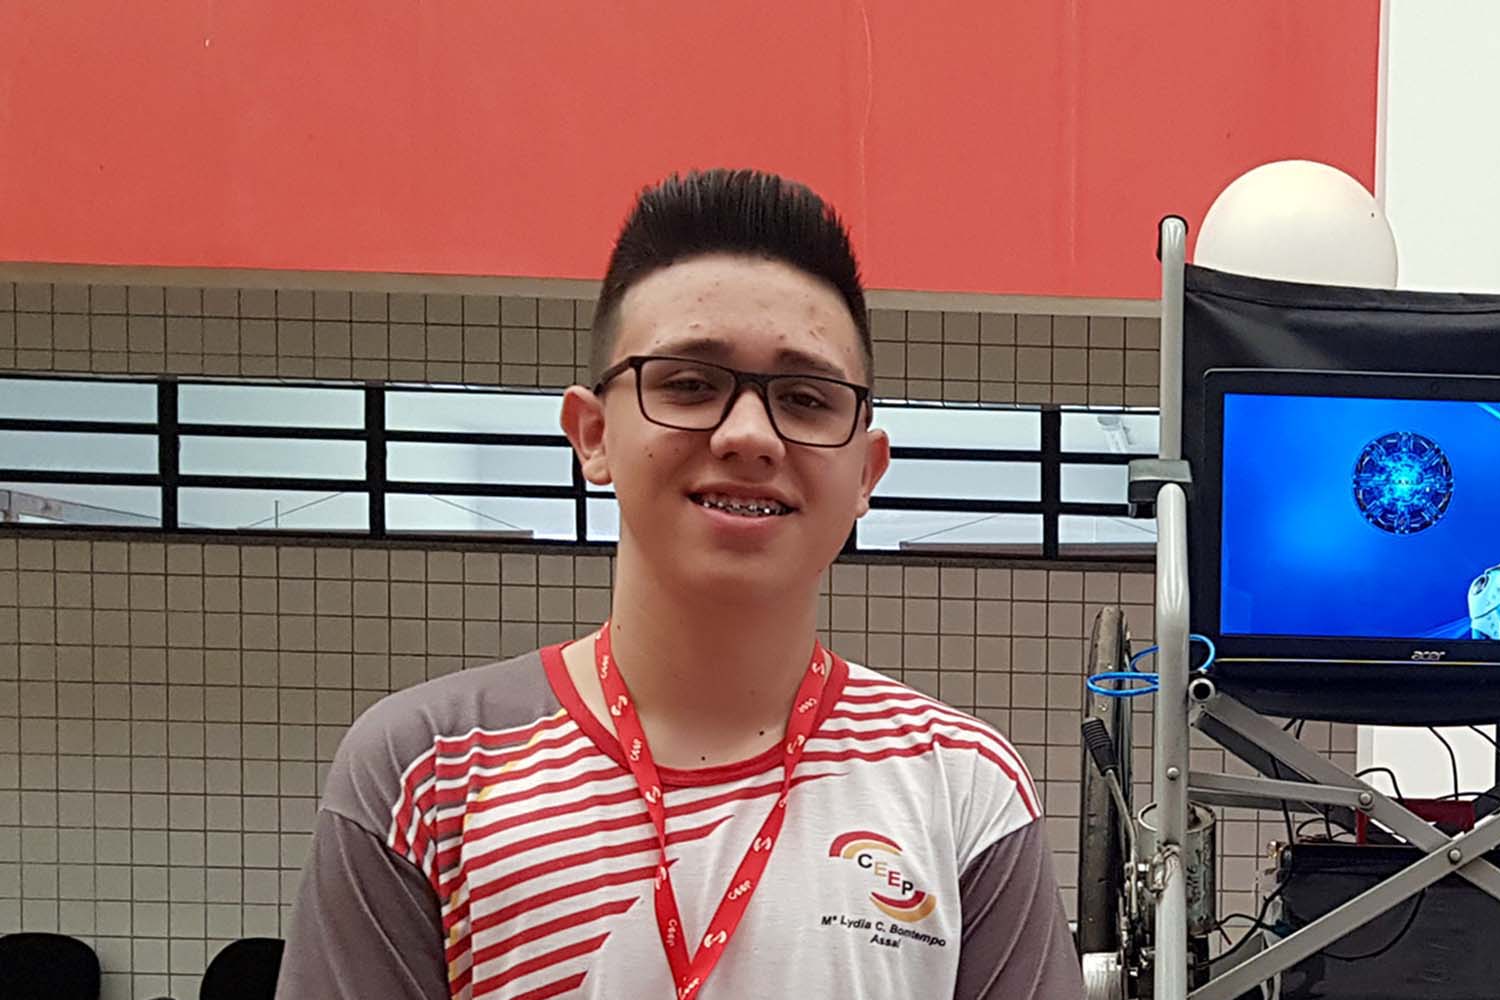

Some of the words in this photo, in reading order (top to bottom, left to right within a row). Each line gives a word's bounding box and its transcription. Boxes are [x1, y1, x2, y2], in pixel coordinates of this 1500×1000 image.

[1410, 650, 1446, 661] acer
[857, 853, 914, 895] CEEP
[840, 915, 872, 929] Lydia
[875, 921, 886, 933] C.
[889, 924, 946, 947] Bontempo
